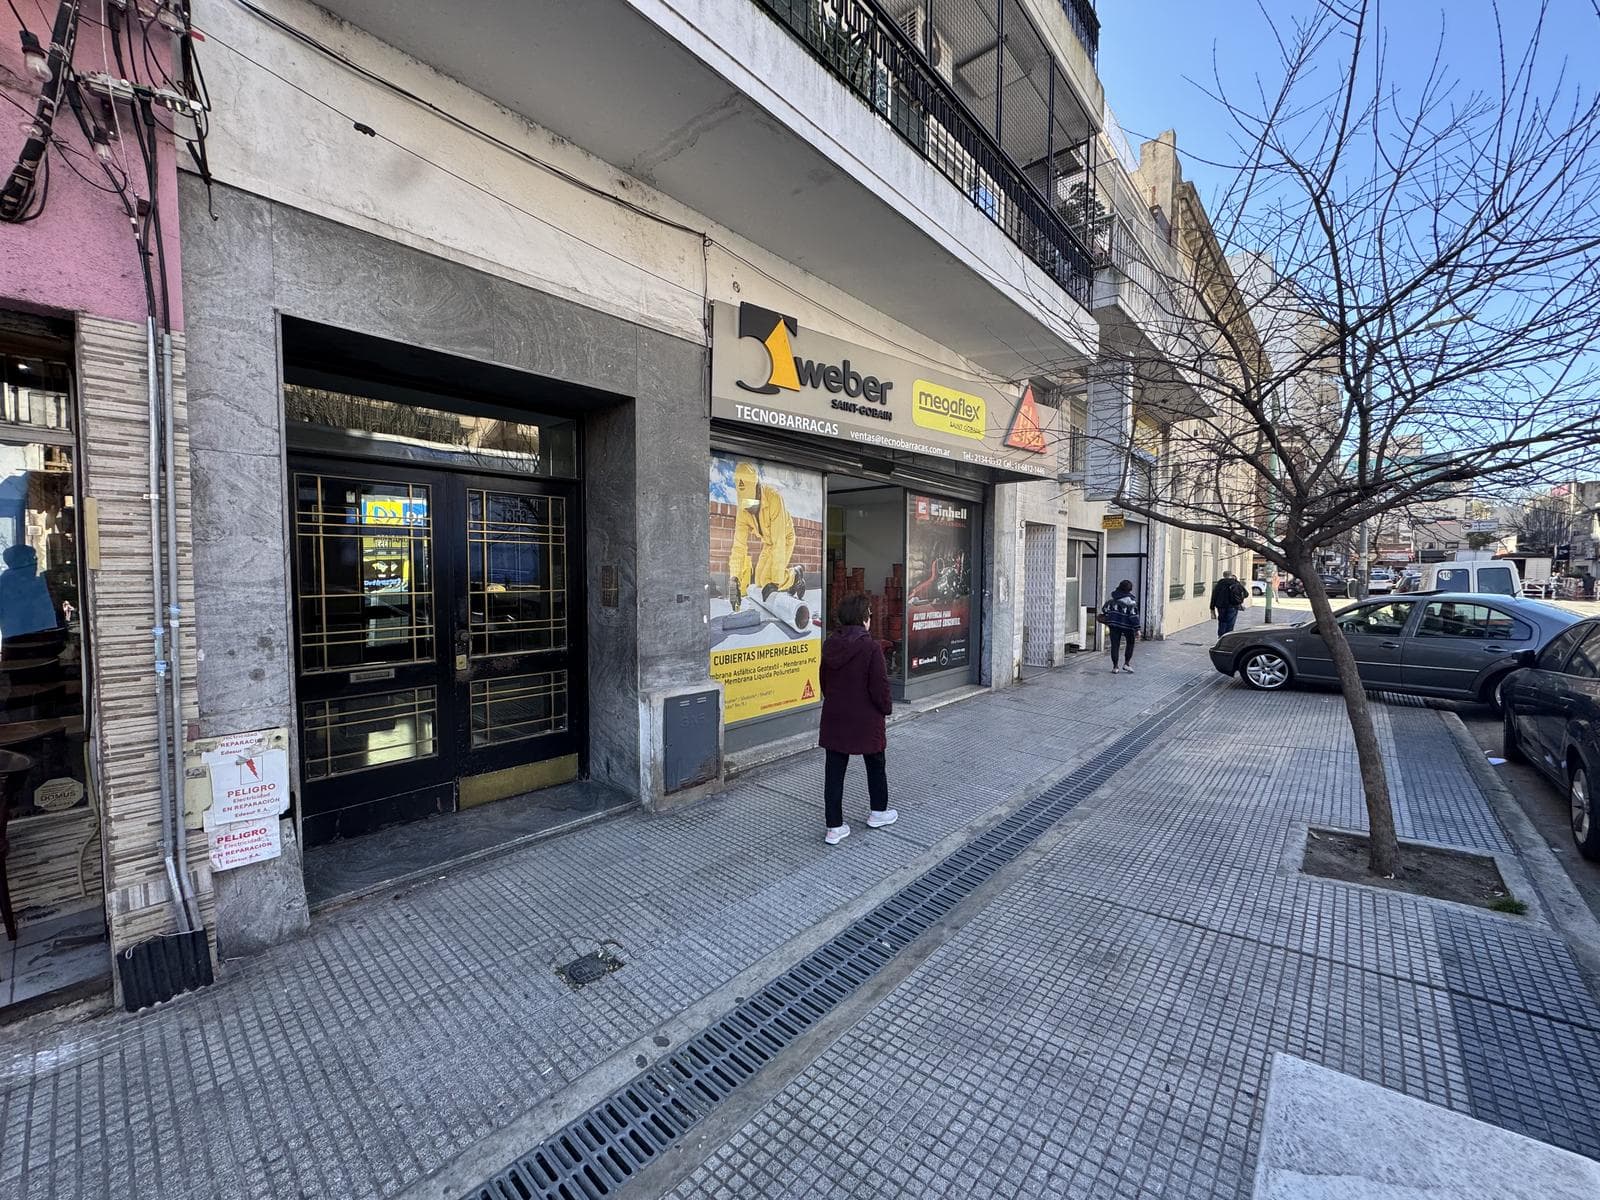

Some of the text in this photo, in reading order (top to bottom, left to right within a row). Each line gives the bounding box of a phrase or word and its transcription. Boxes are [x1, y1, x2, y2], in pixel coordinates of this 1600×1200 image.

[794, 356, 894, 405] weber
[831, 399, 892, 421] SAINT-GOBAIN
[919, 391, 980, 420] megaflex
[735, 404, 839, 435] TECNOBARRACAS
[850, 430, 951, 457] ventas@tecnobarracas.com.ar
[931, 503, 967, 519] Einhell
[713, 643, 809, 666] CUBIERTAS IMPERMEABLES
[784, 659, 808, 668] Membrana
[724, 676, 753, 685] Membrana
[227, 783, 276, 798] PELIGRO
[233, 793, 270, 804] Electricidad
[216, 828, 268, 845] PELIGRO
